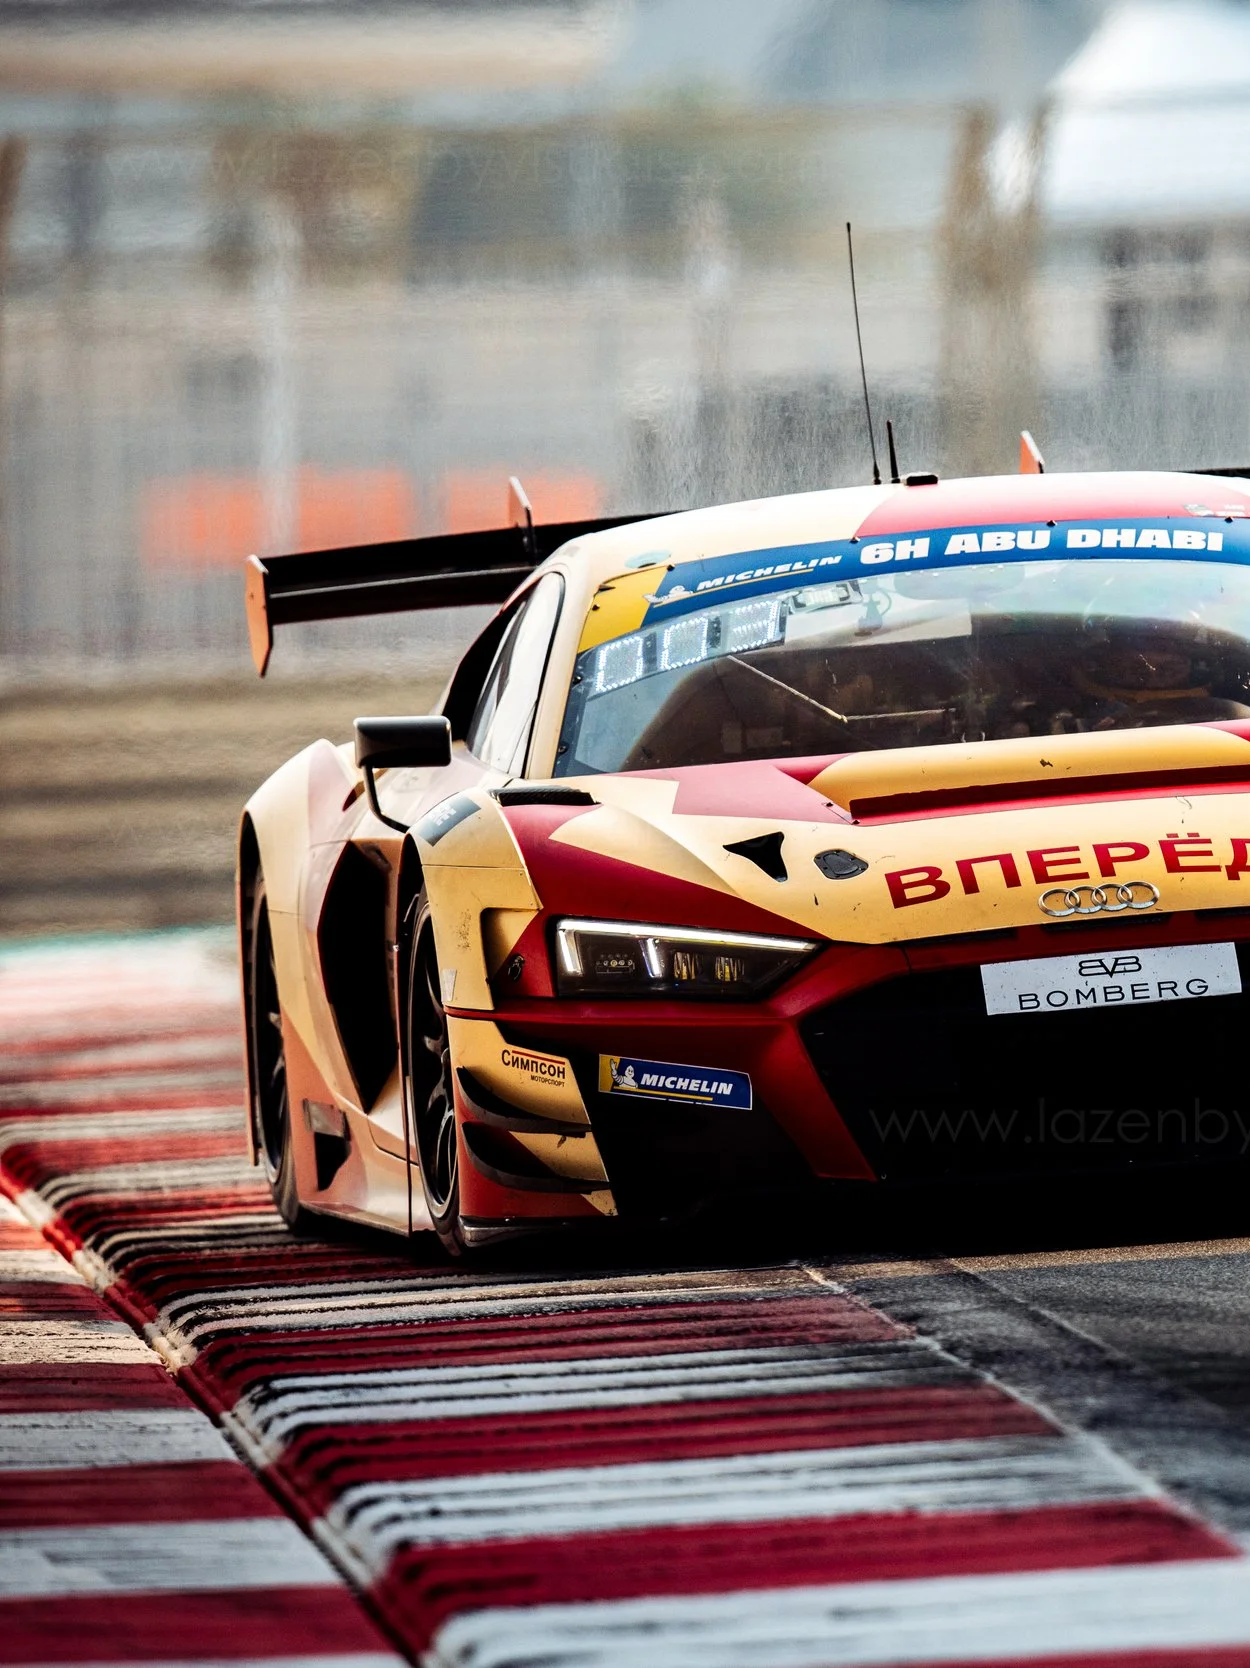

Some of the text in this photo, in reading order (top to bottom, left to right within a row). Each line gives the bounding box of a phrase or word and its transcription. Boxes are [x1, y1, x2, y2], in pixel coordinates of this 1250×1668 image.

[859, 528, 1224, 566] 6H ABU DHABI
[697, 555, 842, 592] MICHELIN
[1018, 977, 1210, 1011] BOMBERG
[640, 1073, 734, 1096] MICHELIN
